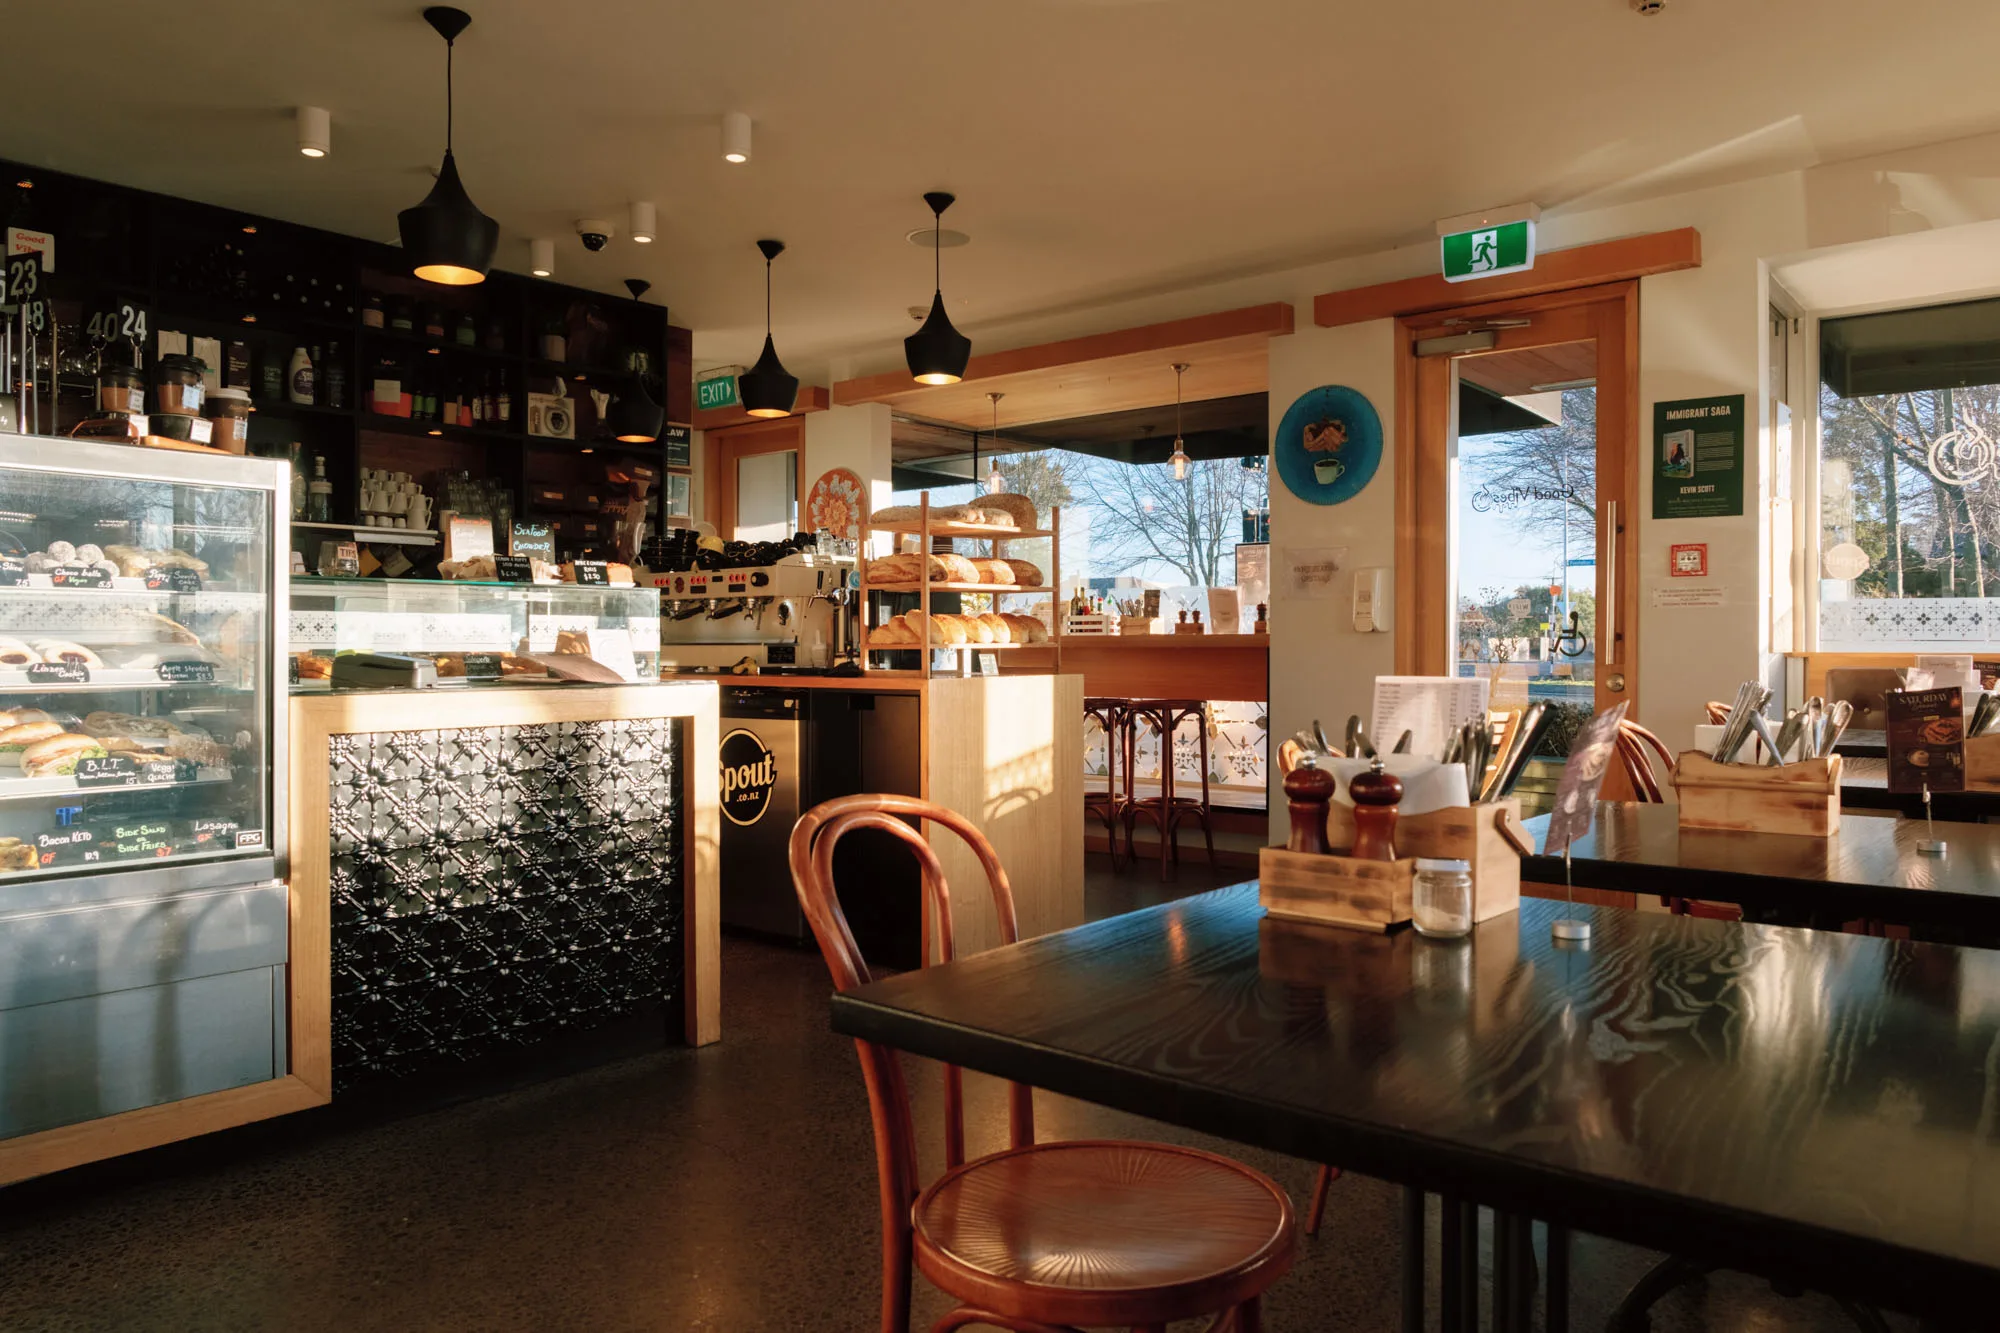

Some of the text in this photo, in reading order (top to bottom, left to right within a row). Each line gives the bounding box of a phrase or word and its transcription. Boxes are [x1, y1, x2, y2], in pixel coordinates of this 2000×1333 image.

[16, 232, 46, 245] Good
[10, 258, 38, 296] 23
[86, 312, 118, 342] 40
[121, 305, 148, 342] 24
[700, 382, 725, 405] EXIT
[1666, 405, 1731, 421] IMMIGRANT SAGA
[1680, 484, 1715, 494] KEVIN SCOTT
[514, 523, 549, 537] SEAFOOD
[512, 540, 551, 552] CHOWDER
[339, 548, 357, 559] TIPS
[736, 791, 759, 803] .co.nz
[116, 825, 166, 838] SIDE SALAD
[39, 831, 92, 847] Bacon KETO
[239, 834, 261, 844] FPG
[117, 841, 166, 853] SIDE FRIES
[41, 853, 56, 864] GF
